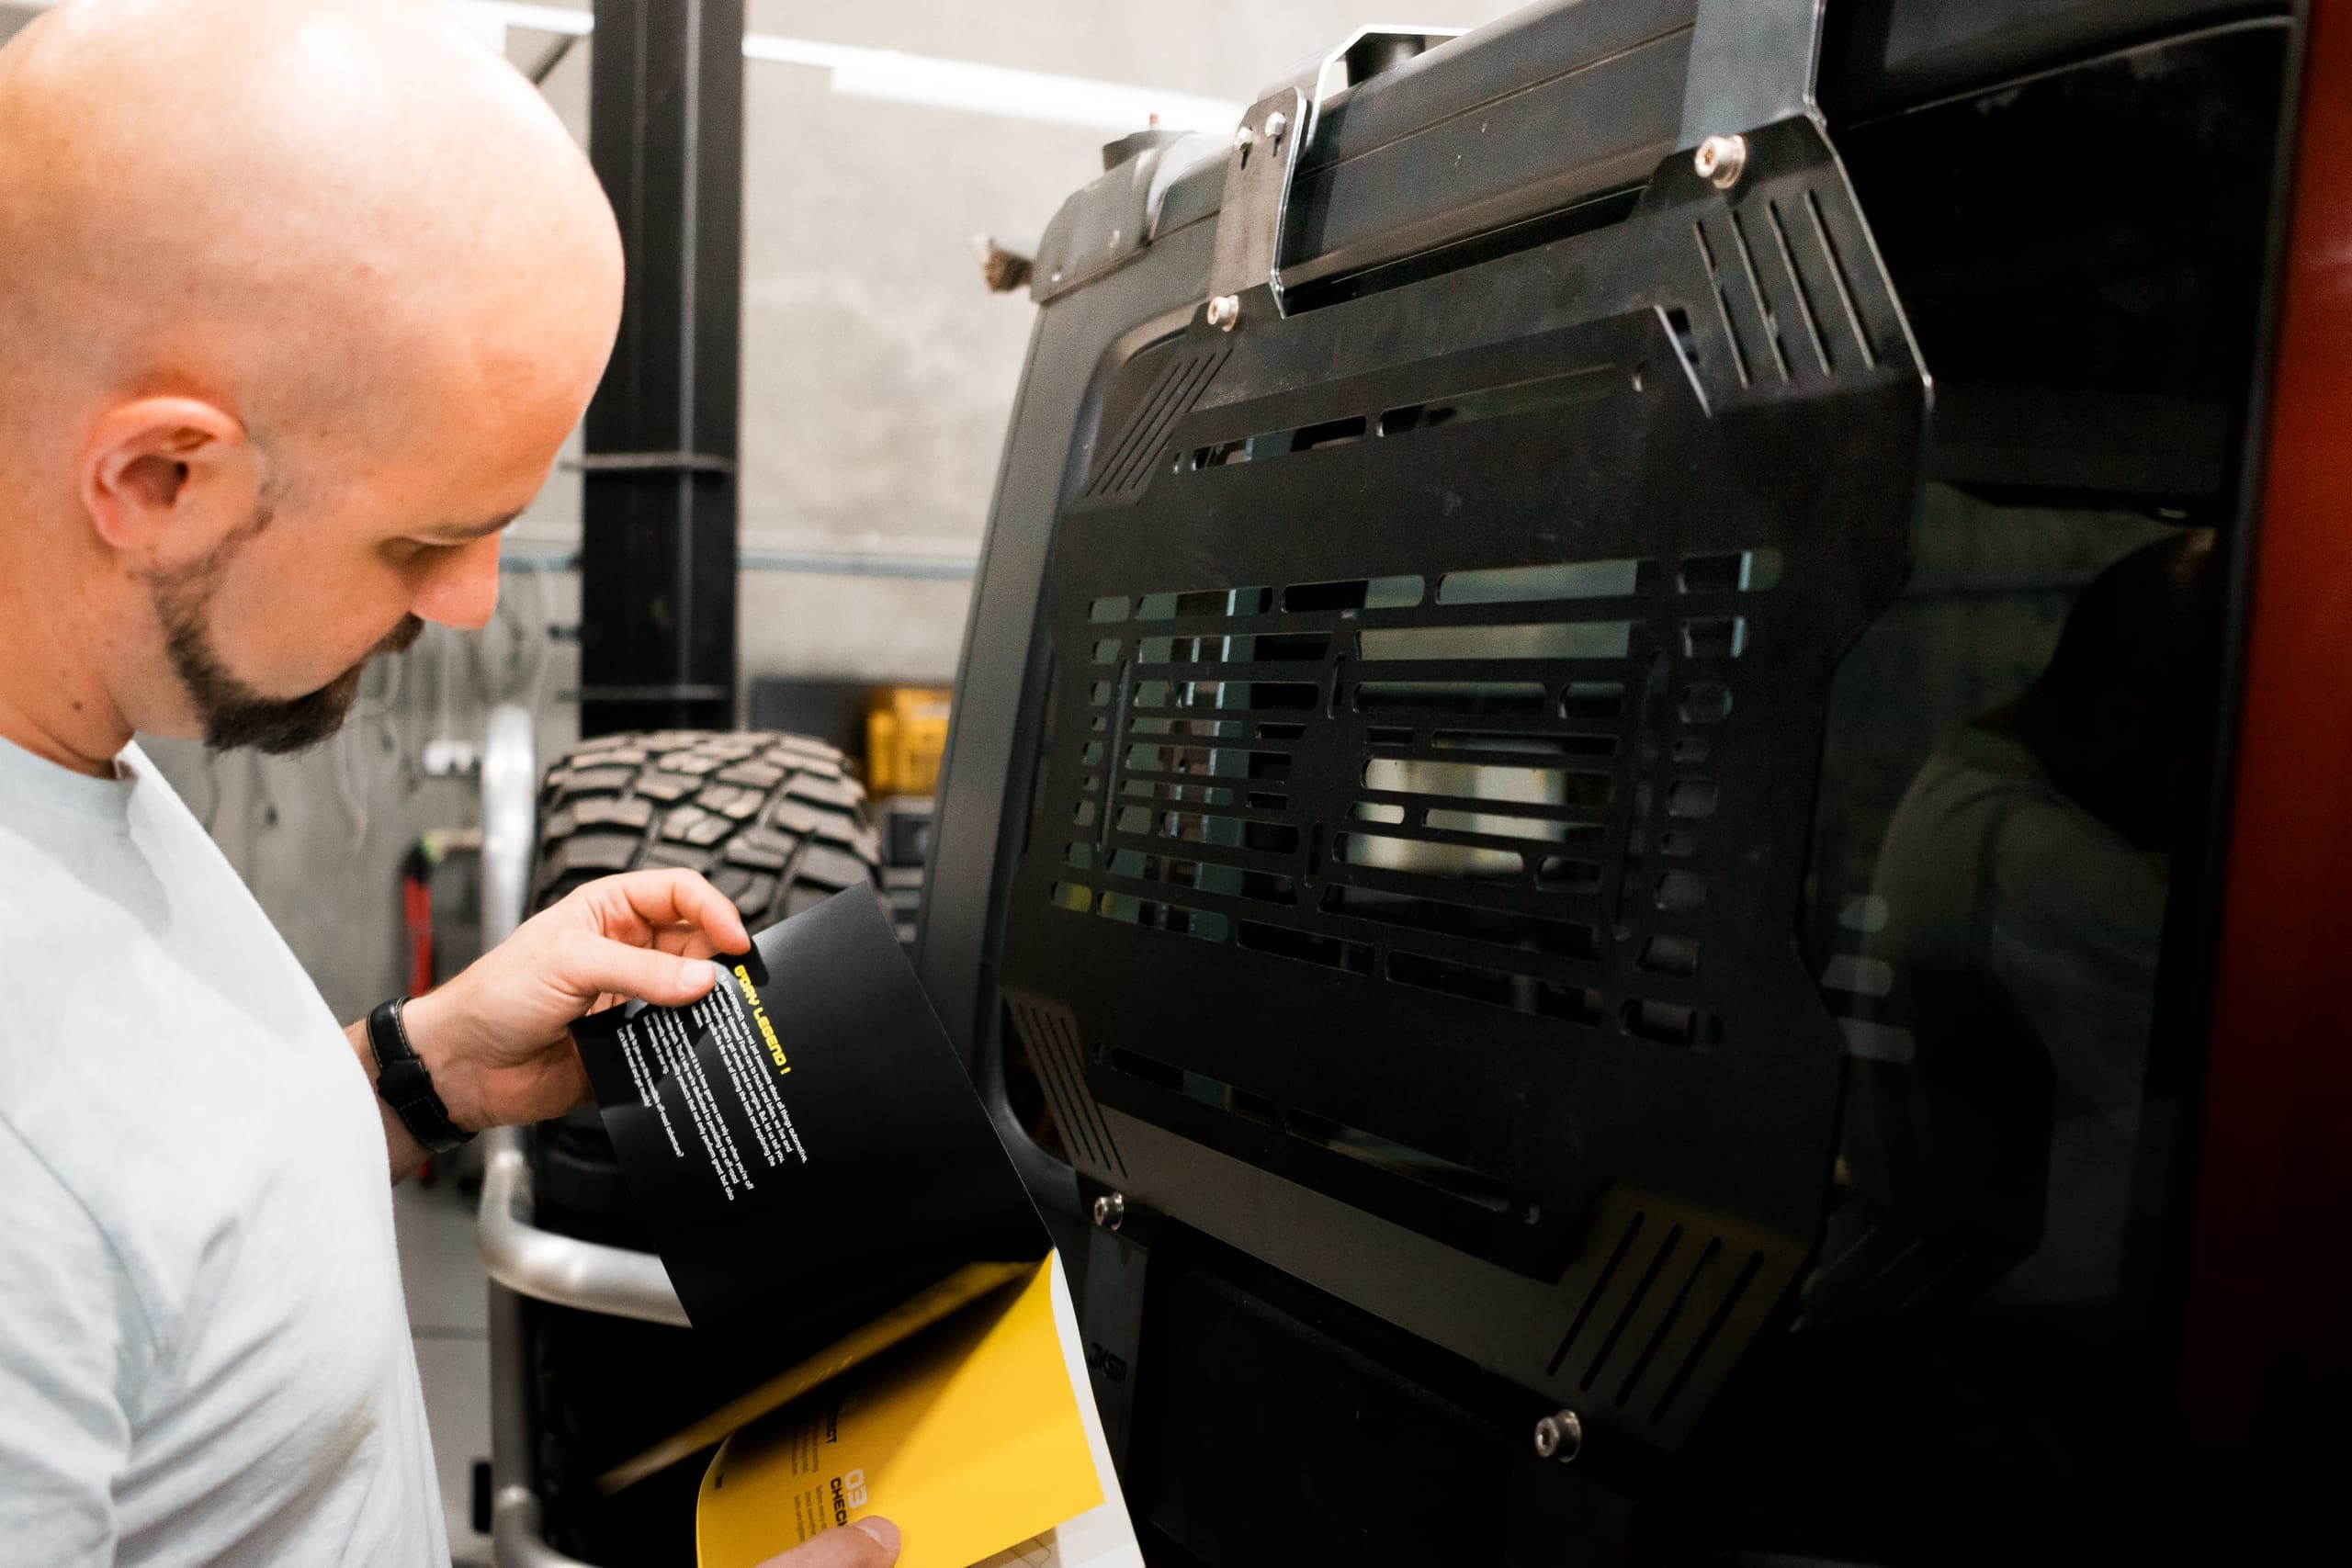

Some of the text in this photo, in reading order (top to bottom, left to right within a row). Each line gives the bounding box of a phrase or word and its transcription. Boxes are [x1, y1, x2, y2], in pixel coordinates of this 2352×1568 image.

[753, 1008, 786, 1066] LEGEND
[780, 1066, 791, 1075] !
[676, 1075, 690, 1100] products
[701, 1134, 716, 1158] perform
[711, 1158, 724, 1176] great
[731, 1072, 742, 1092] hitting
[755, 1128, 770, 1156] exploring
[749, 1090, 761, 1111] engine.
[752, 1073, 763, 1091] trucks
[766, 1101, 776, 1120] bikes,
[768, 1084, 780, 1102] about
[780, 1109, 792, 1128] things
[788, 1127, 807, 1163] automotive,
[693, 1086, 709, 1113] dedicated
[707, 1120, 722, 1148] providing
[724, 1158, 740, 1184] off-road
[729, 1145, 740, 1161] when
[735, 1161, 748, 1180] you're
[846, 1468, 868, 1509] 03
